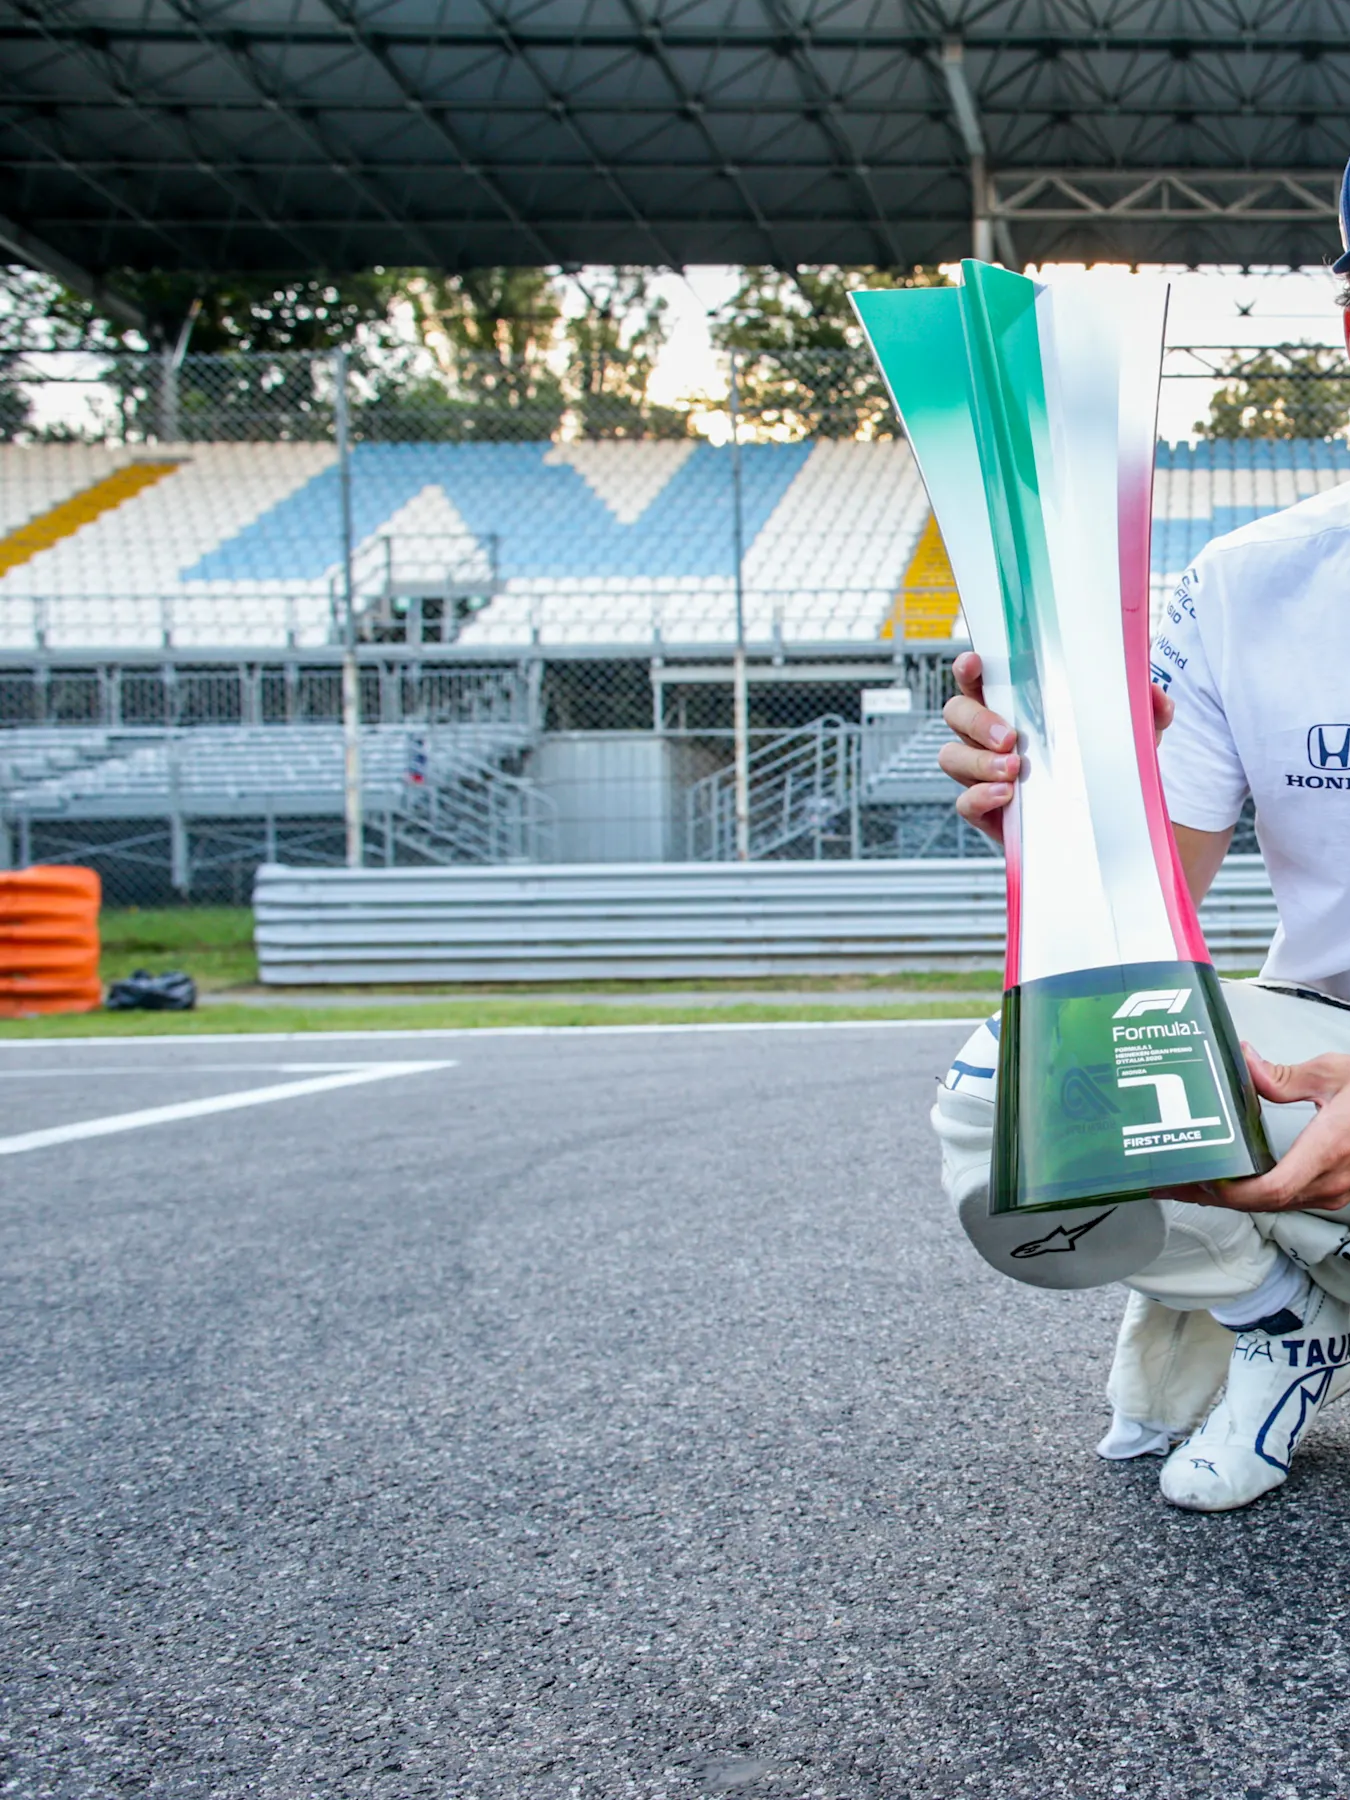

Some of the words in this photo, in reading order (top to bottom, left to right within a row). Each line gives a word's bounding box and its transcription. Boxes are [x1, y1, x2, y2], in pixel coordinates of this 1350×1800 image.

[1156, 634, 1188, 670] World
[1115, 1045, 1148, 1054] FORMULA
[1115, 1050, 1150, 1059] HEINEKEN
[1151, 1048, 1169, 1056] GRAN
[1170, 1046, 1192, 1054] PREMIO
[1117, 1073, 1221, 1136] 1
[1123, 1135, 1160, 1148] FIRST
[1163, 1130, 1202, 1143] PLACE
